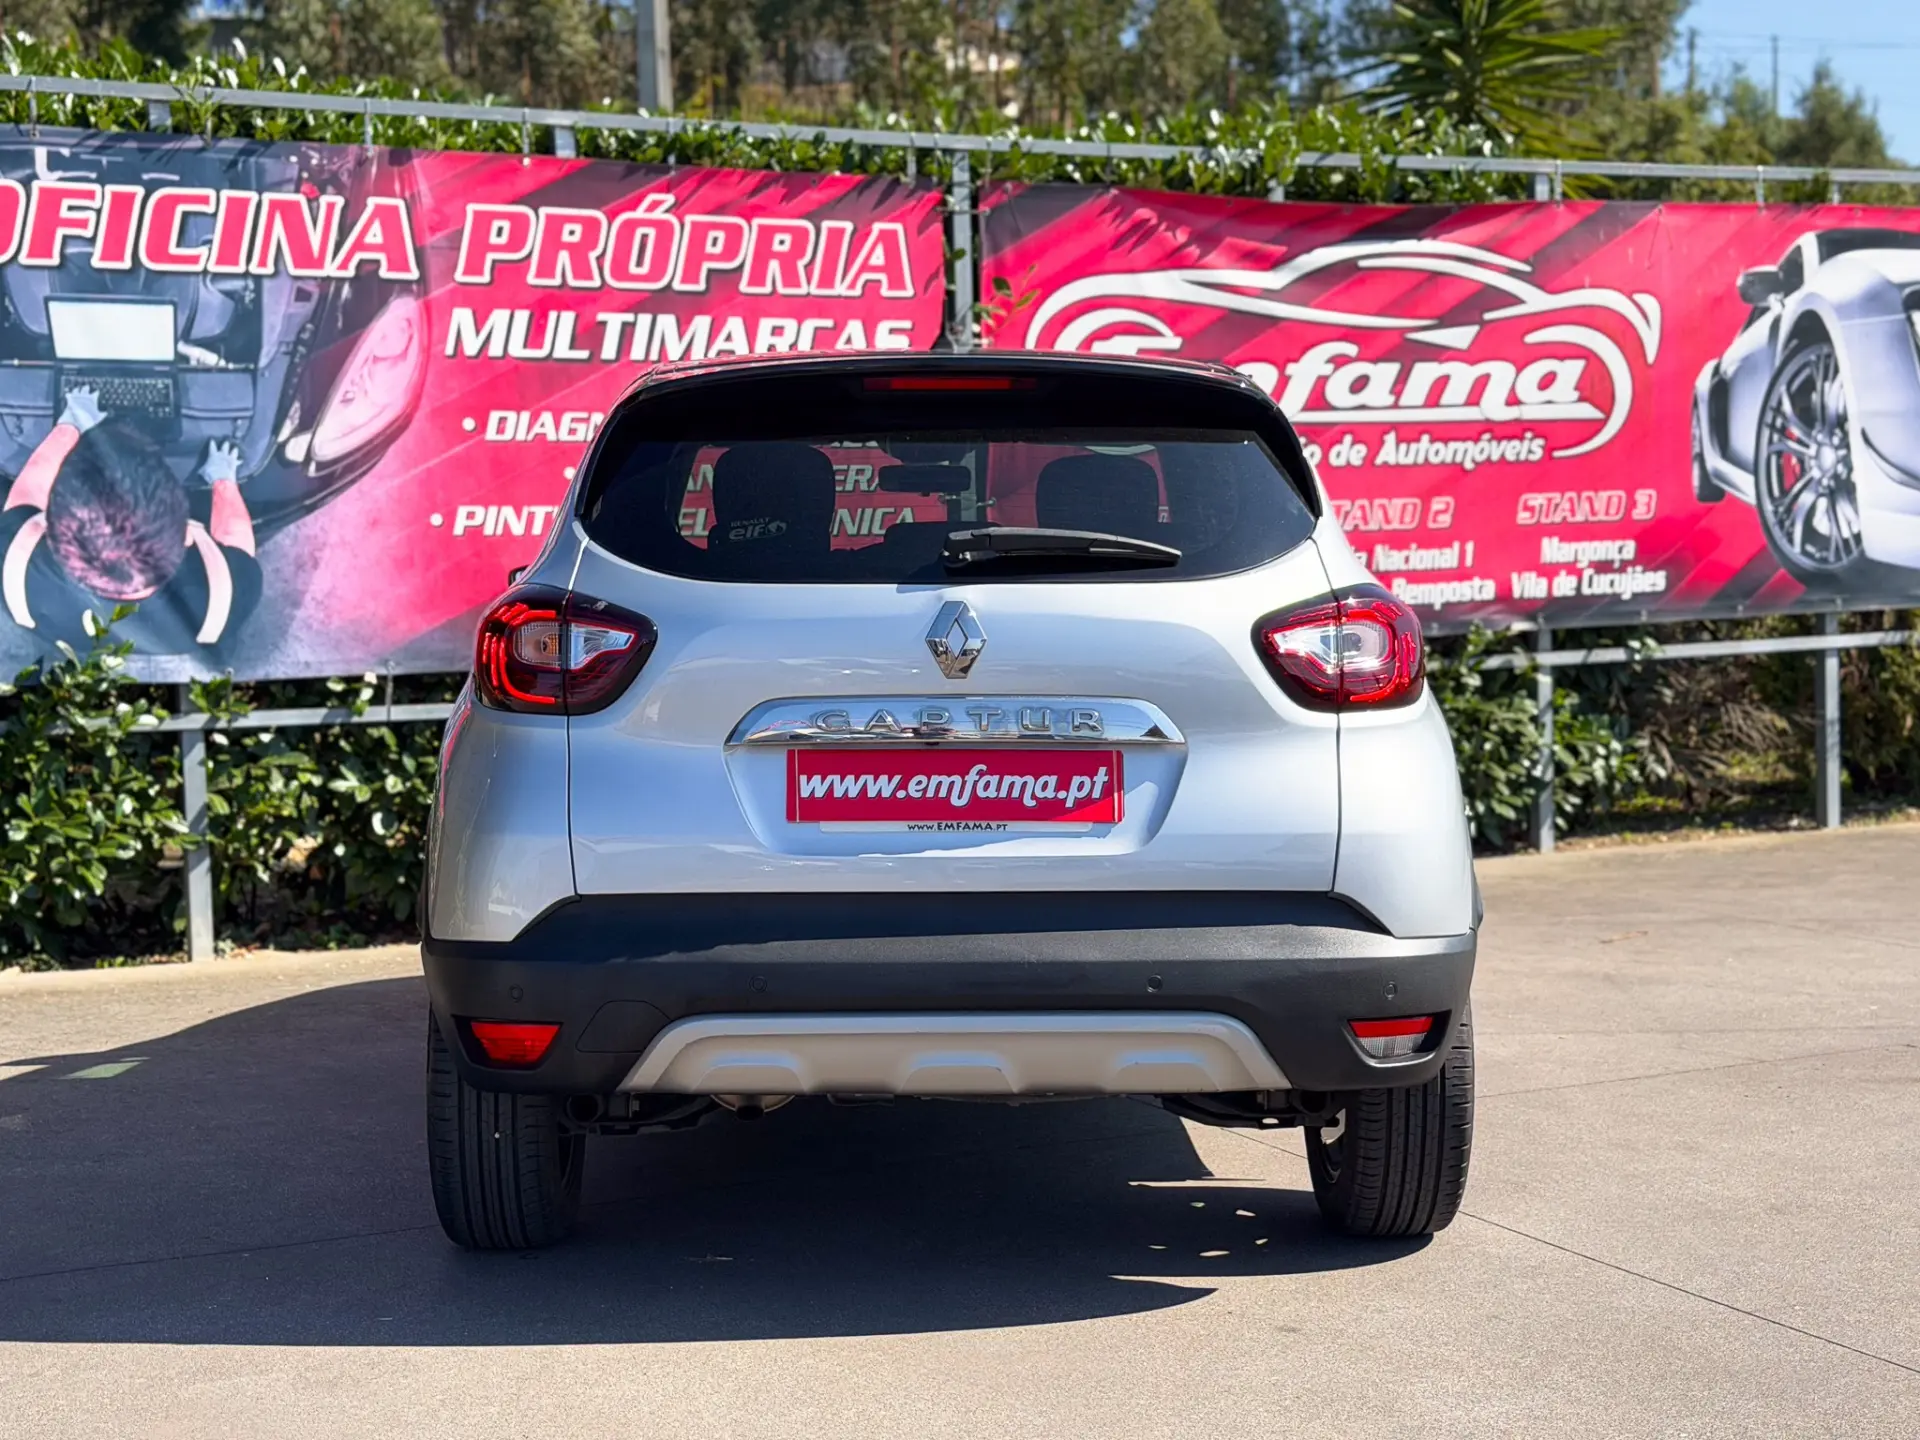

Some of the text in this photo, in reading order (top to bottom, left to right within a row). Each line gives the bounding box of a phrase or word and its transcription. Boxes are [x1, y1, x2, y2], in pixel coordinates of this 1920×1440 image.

[454, 193, 915, 297] PRÓPRIA
[1328, 432, 1367, 466] de
[1375, 427, 1546, 470] Automóveis
[452, 505, 562, 537] PINT
[1427, 495, 1455, 529] 2
[1516, 488, 1658, 525] STAND 3
[729, 524, 765, 540] elf
[1372, 540, 1461, 573] Nacional
[1511, 571, 1548, 599] Vila
[1552, 569, 1578, 598] de
[814, 707, 1104, 732] CAPTUR
[798, 764, 1109, 808] www.emfama.pt
